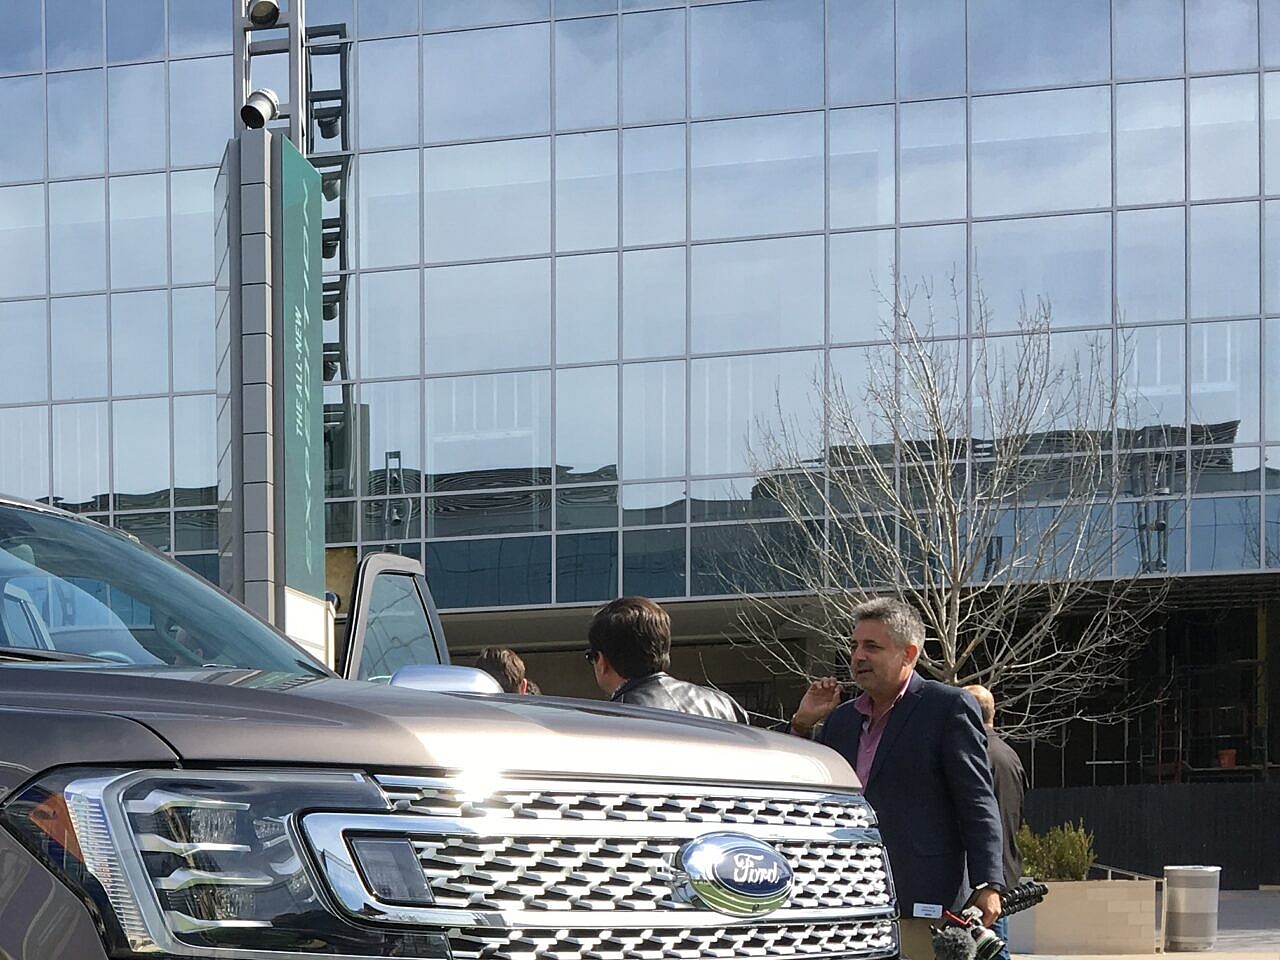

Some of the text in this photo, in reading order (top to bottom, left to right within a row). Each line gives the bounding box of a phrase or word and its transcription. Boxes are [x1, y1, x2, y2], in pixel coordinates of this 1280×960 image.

[295, 305, 303, 437] THE ALL-NEW
[733, 853, 780, 884] Ford
